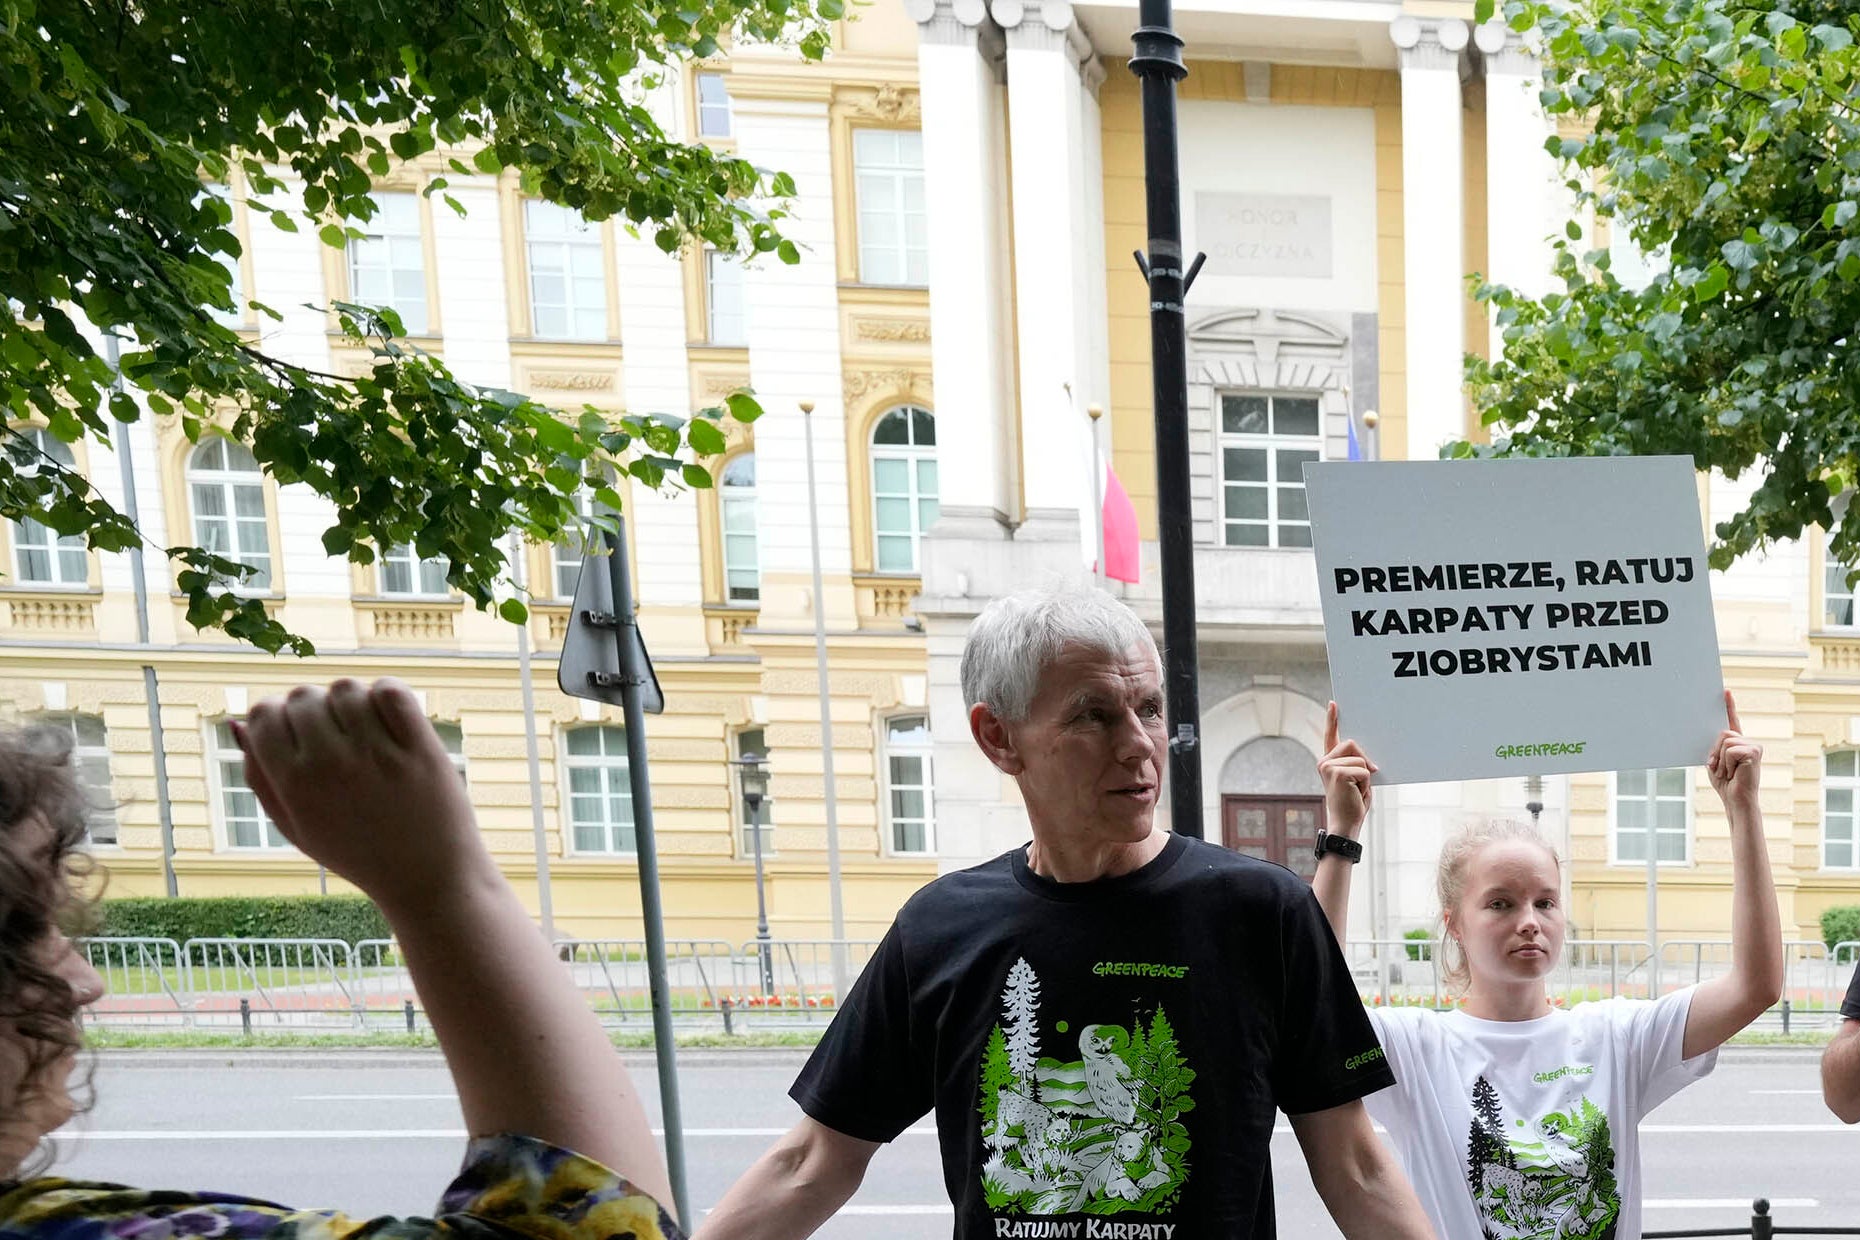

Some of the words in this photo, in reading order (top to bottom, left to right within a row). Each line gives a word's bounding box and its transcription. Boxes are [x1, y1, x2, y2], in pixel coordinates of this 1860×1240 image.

[1334, 561, 1566, 594] PREMIERZE,
[1577, 557, 1695, 586] RATUJ
[1352, 604, 1534, 637] KARPATY
[1547, 599, 1669, 629] PRZED
[1392, 640, 1652, 678] ZIOBRYSTAMI
[1495, 741, 1587, 760] GREENPEACE
[1092, 961, 1190, 979] GREENPEACE
[995, 1218, 1082, 1240] RATUJMY
